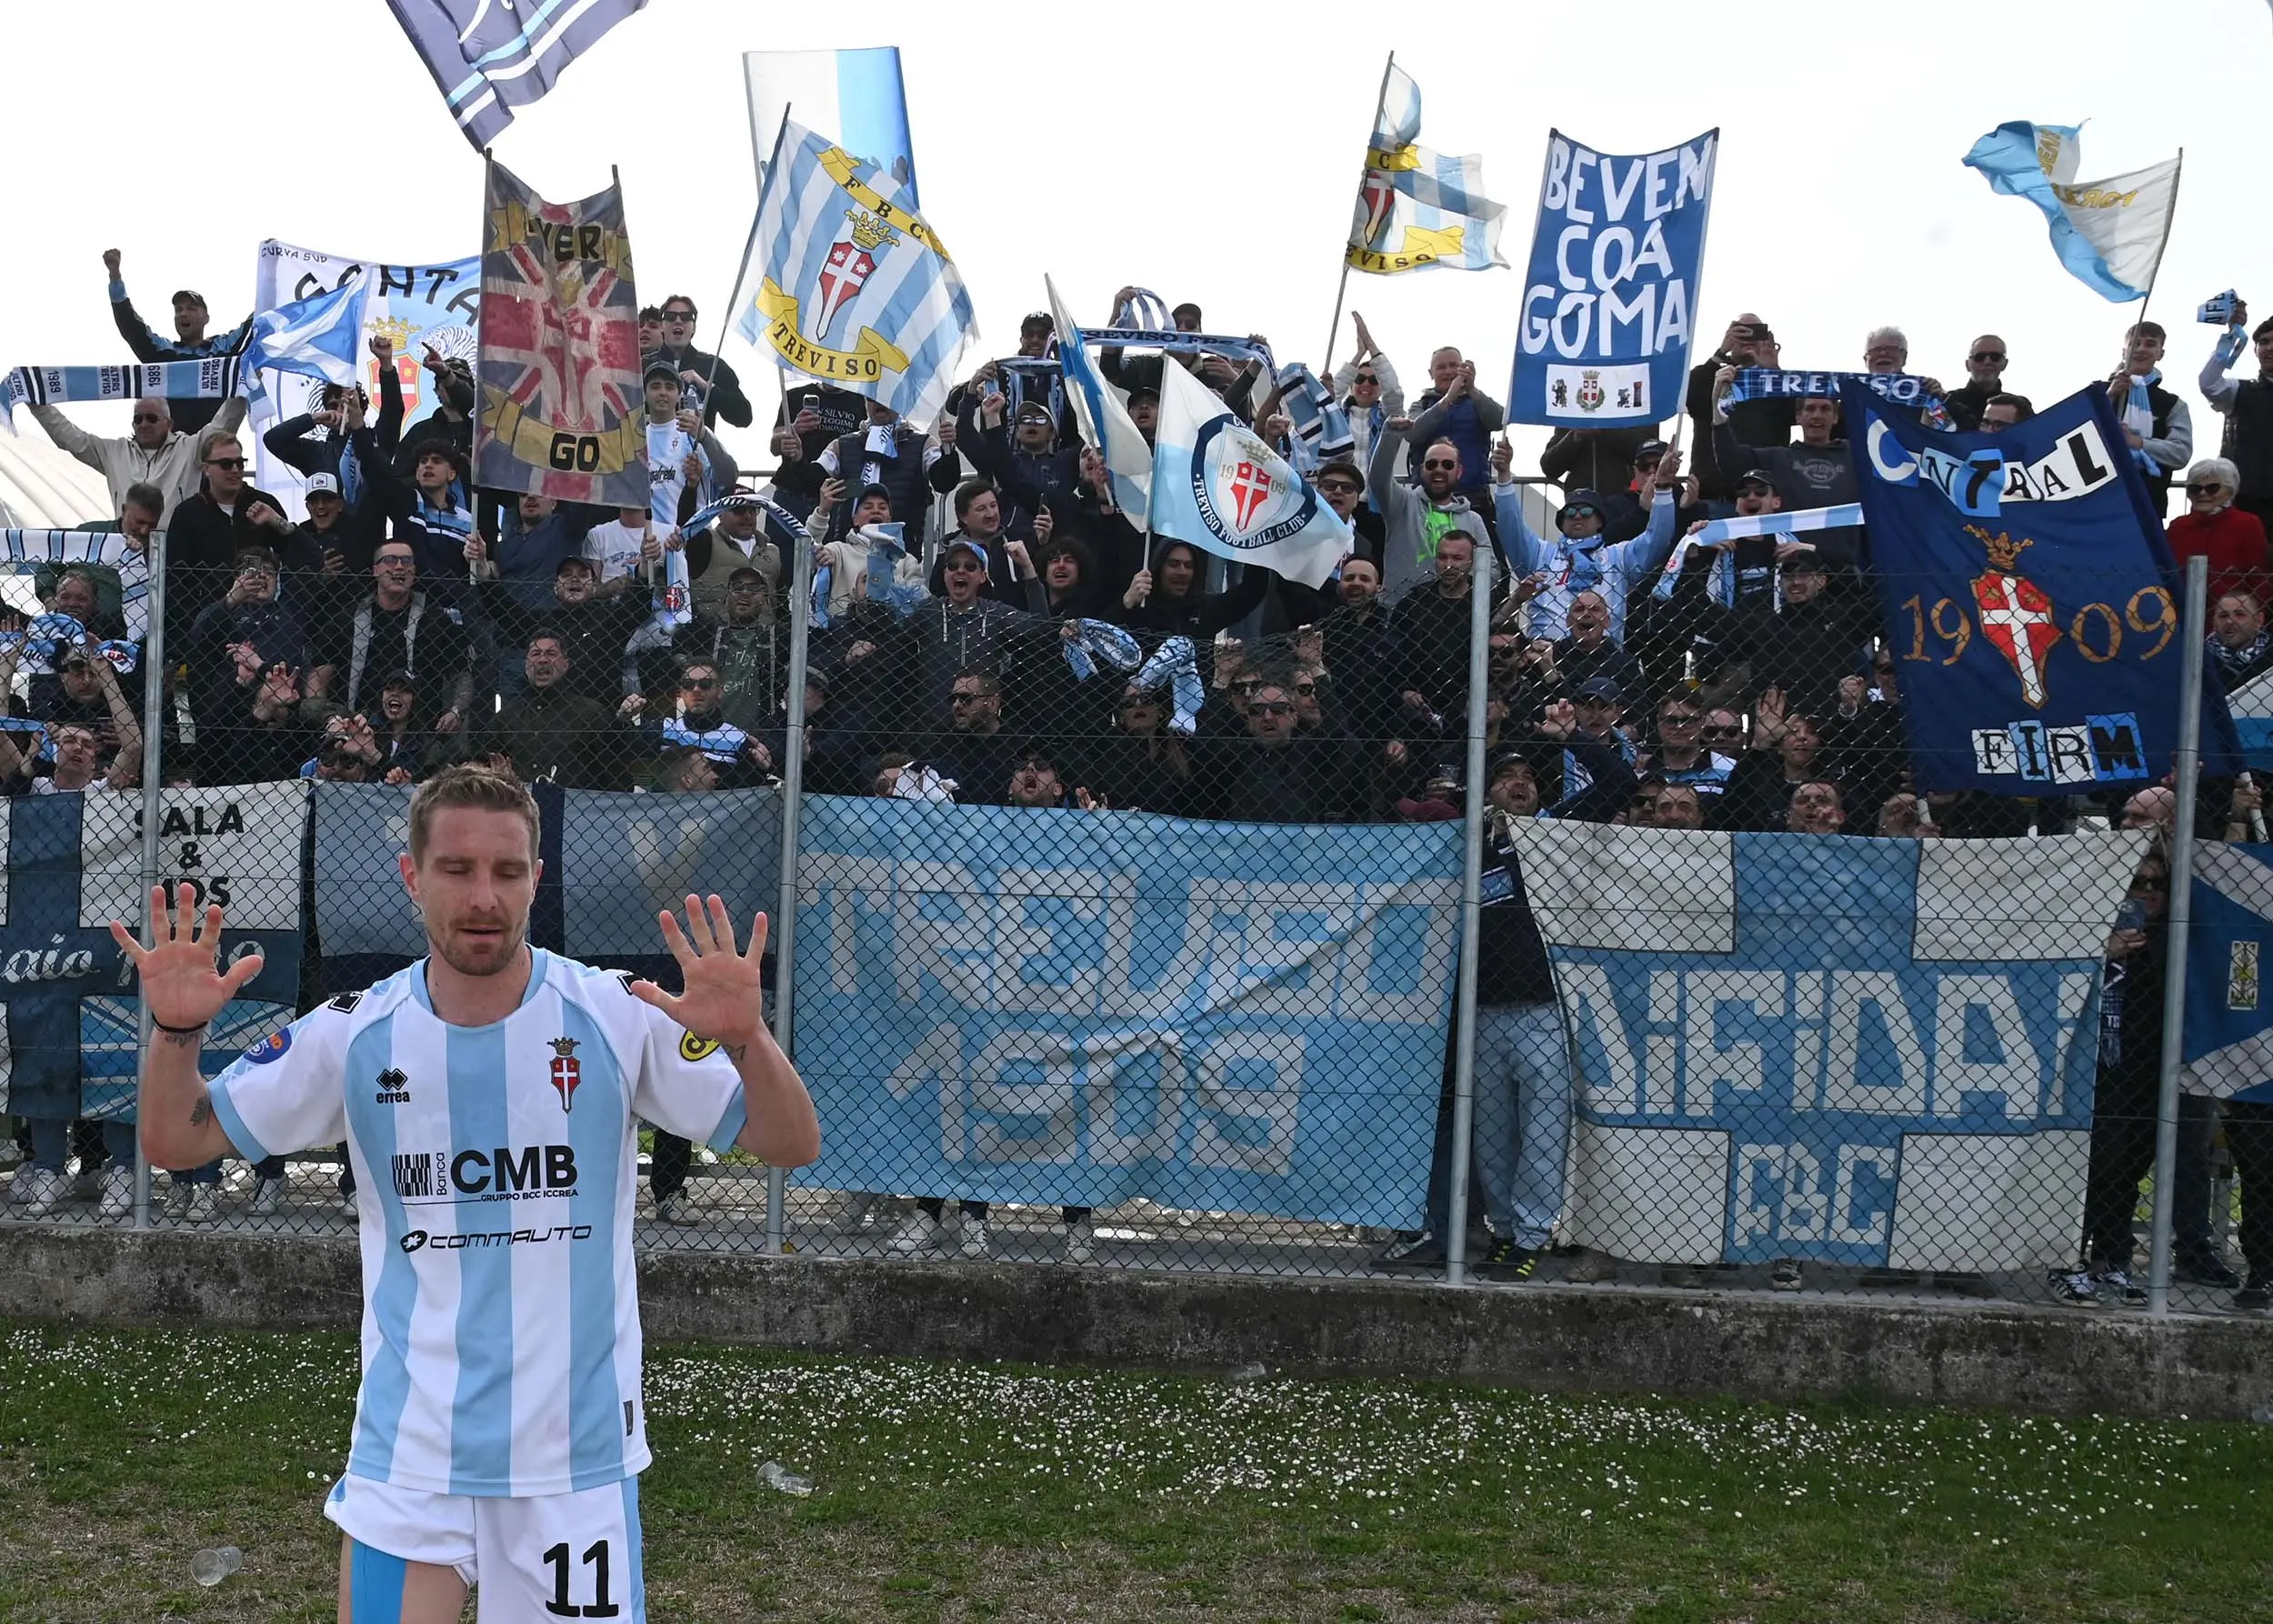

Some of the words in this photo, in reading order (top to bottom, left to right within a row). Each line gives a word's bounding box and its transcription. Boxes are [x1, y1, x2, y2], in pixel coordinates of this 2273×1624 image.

[1544, 135, 1714, 224] BEVEN
[261, 246, 298, 258] CURVA
[304, 253, 328, 263] SUD
[528, 217, 602, 263] VER
[1521, 278, 1688, 359] GOMA
[772, 323, 877, 376] TREVISO
[47, 370, 62, 394] 1989
[148, 366, 160, 387] 1989
[549, 432, 600, 473] GO
[1219, 464, 1235, 480] 19
[1867, 418, 2108, 509] CNTRAL
[1193, 479, 1221, 530] TREVISO
[1217, 528, 1276, 549] FOOTBALL
[1277, 516, 1307, 538] CLUB
[1901, 594, 1972, 667] 19
[2069, 586, 2178, 664] 09
[1978, 724, 2142, 780] FIRM
[375, 1091, 411, 1104] errea
[436, 1152, 446, 1196] Banca
[450, 1145, 578, 1194] CMB
[480, 1192, 520, 1202] GRUPPO
[522, 1190, 541, 1200] BCC
[543, 1189, 579, 1198] ICCREA
[429, 1225, 592, 1249] COMMAUTO
[542, 1539, 619, 1619] 11
